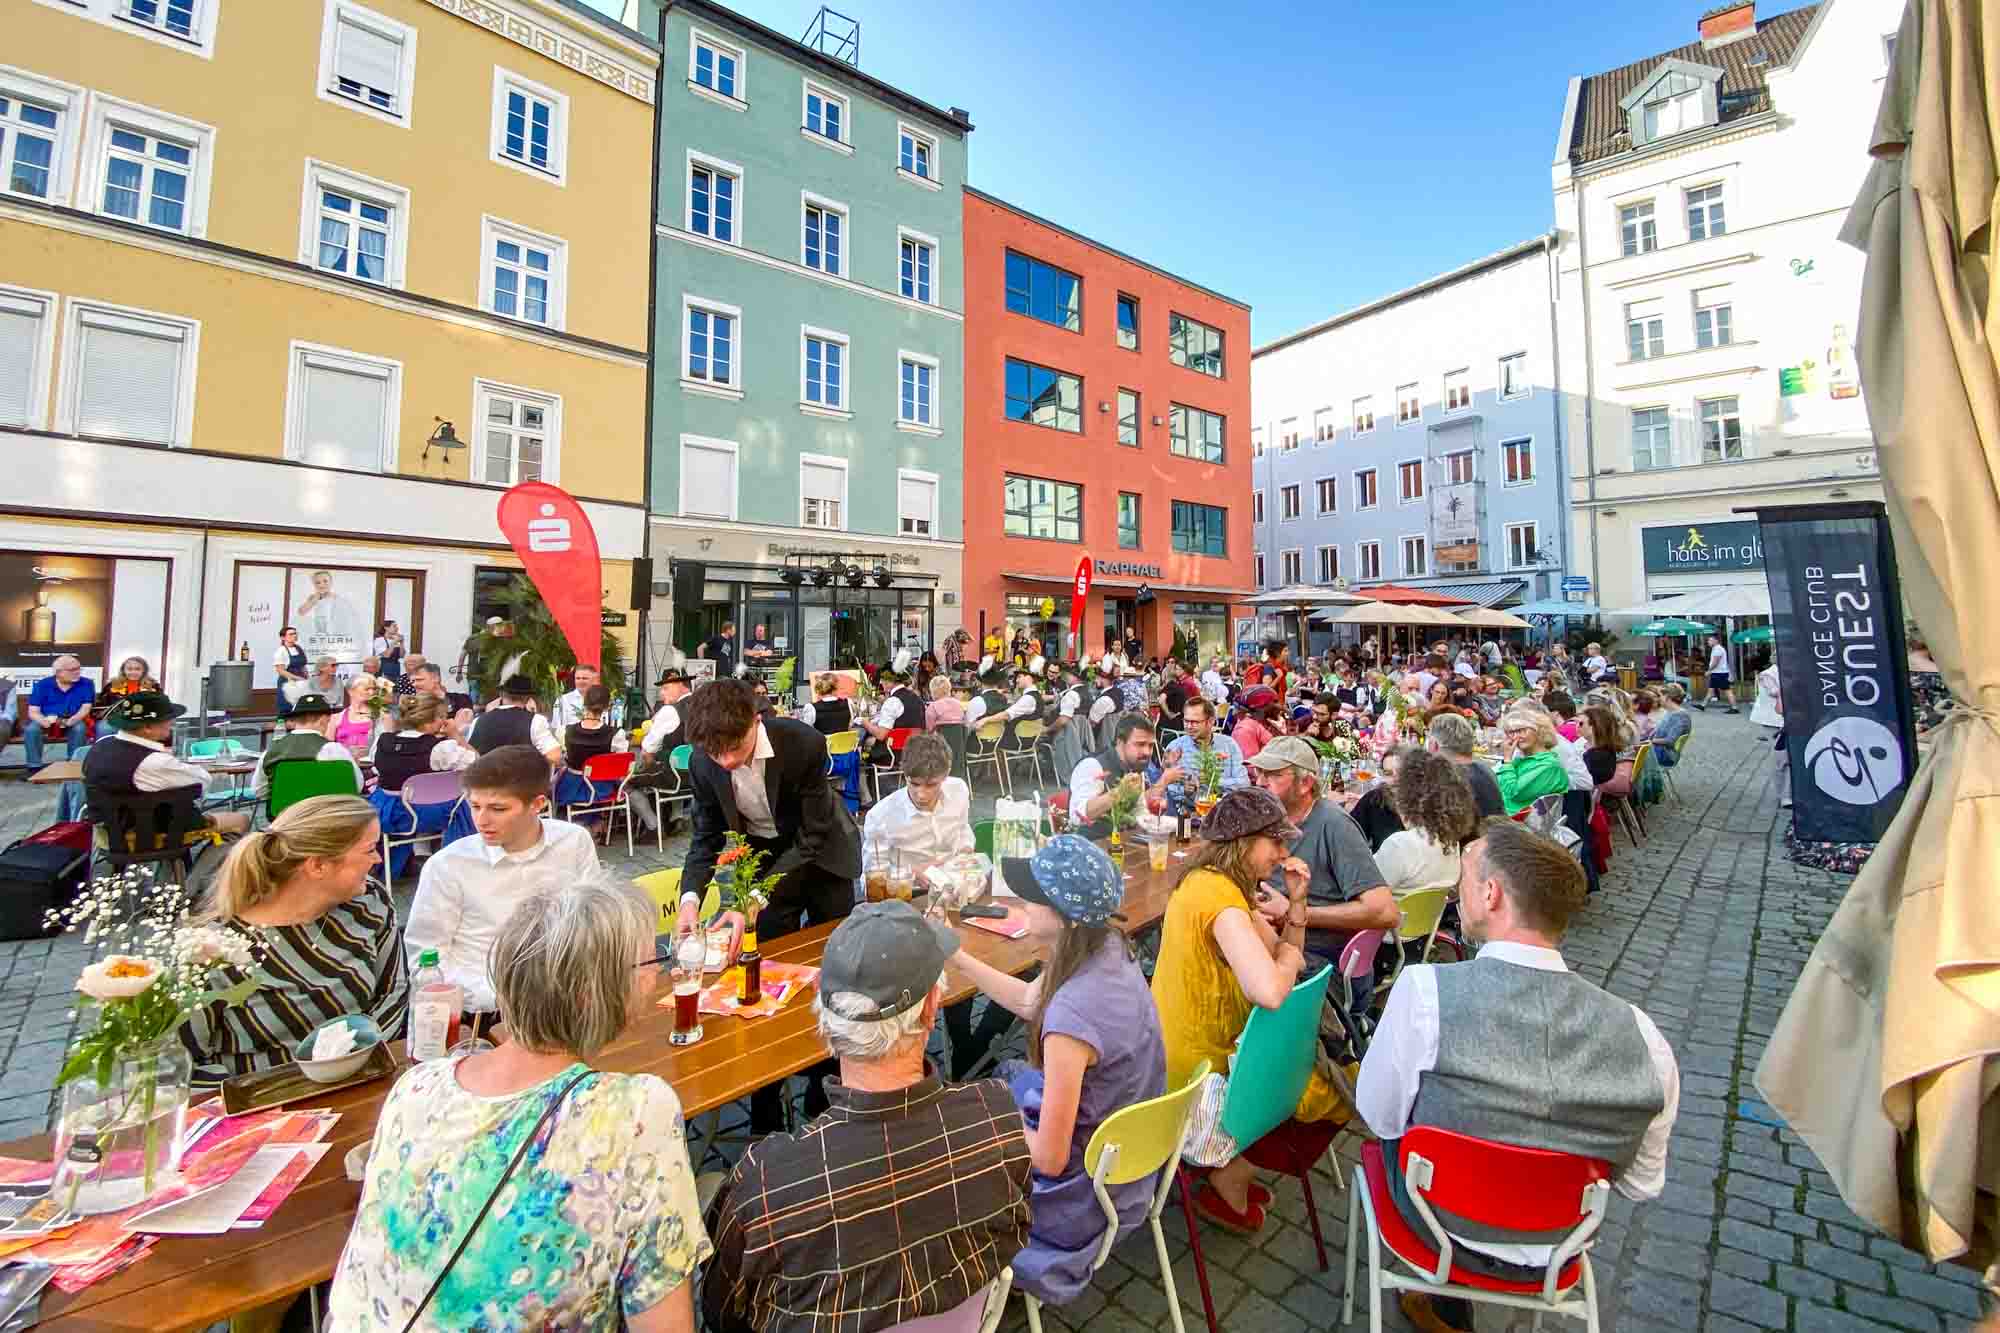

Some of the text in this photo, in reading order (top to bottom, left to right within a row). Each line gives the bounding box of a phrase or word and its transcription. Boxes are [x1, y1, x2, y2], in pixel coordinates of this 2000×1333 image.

[1667, 539, 1710, 562] hans
[1713, 544, 1736, 560] im
[1094, 560, 1165, 578] RAPHAEL
